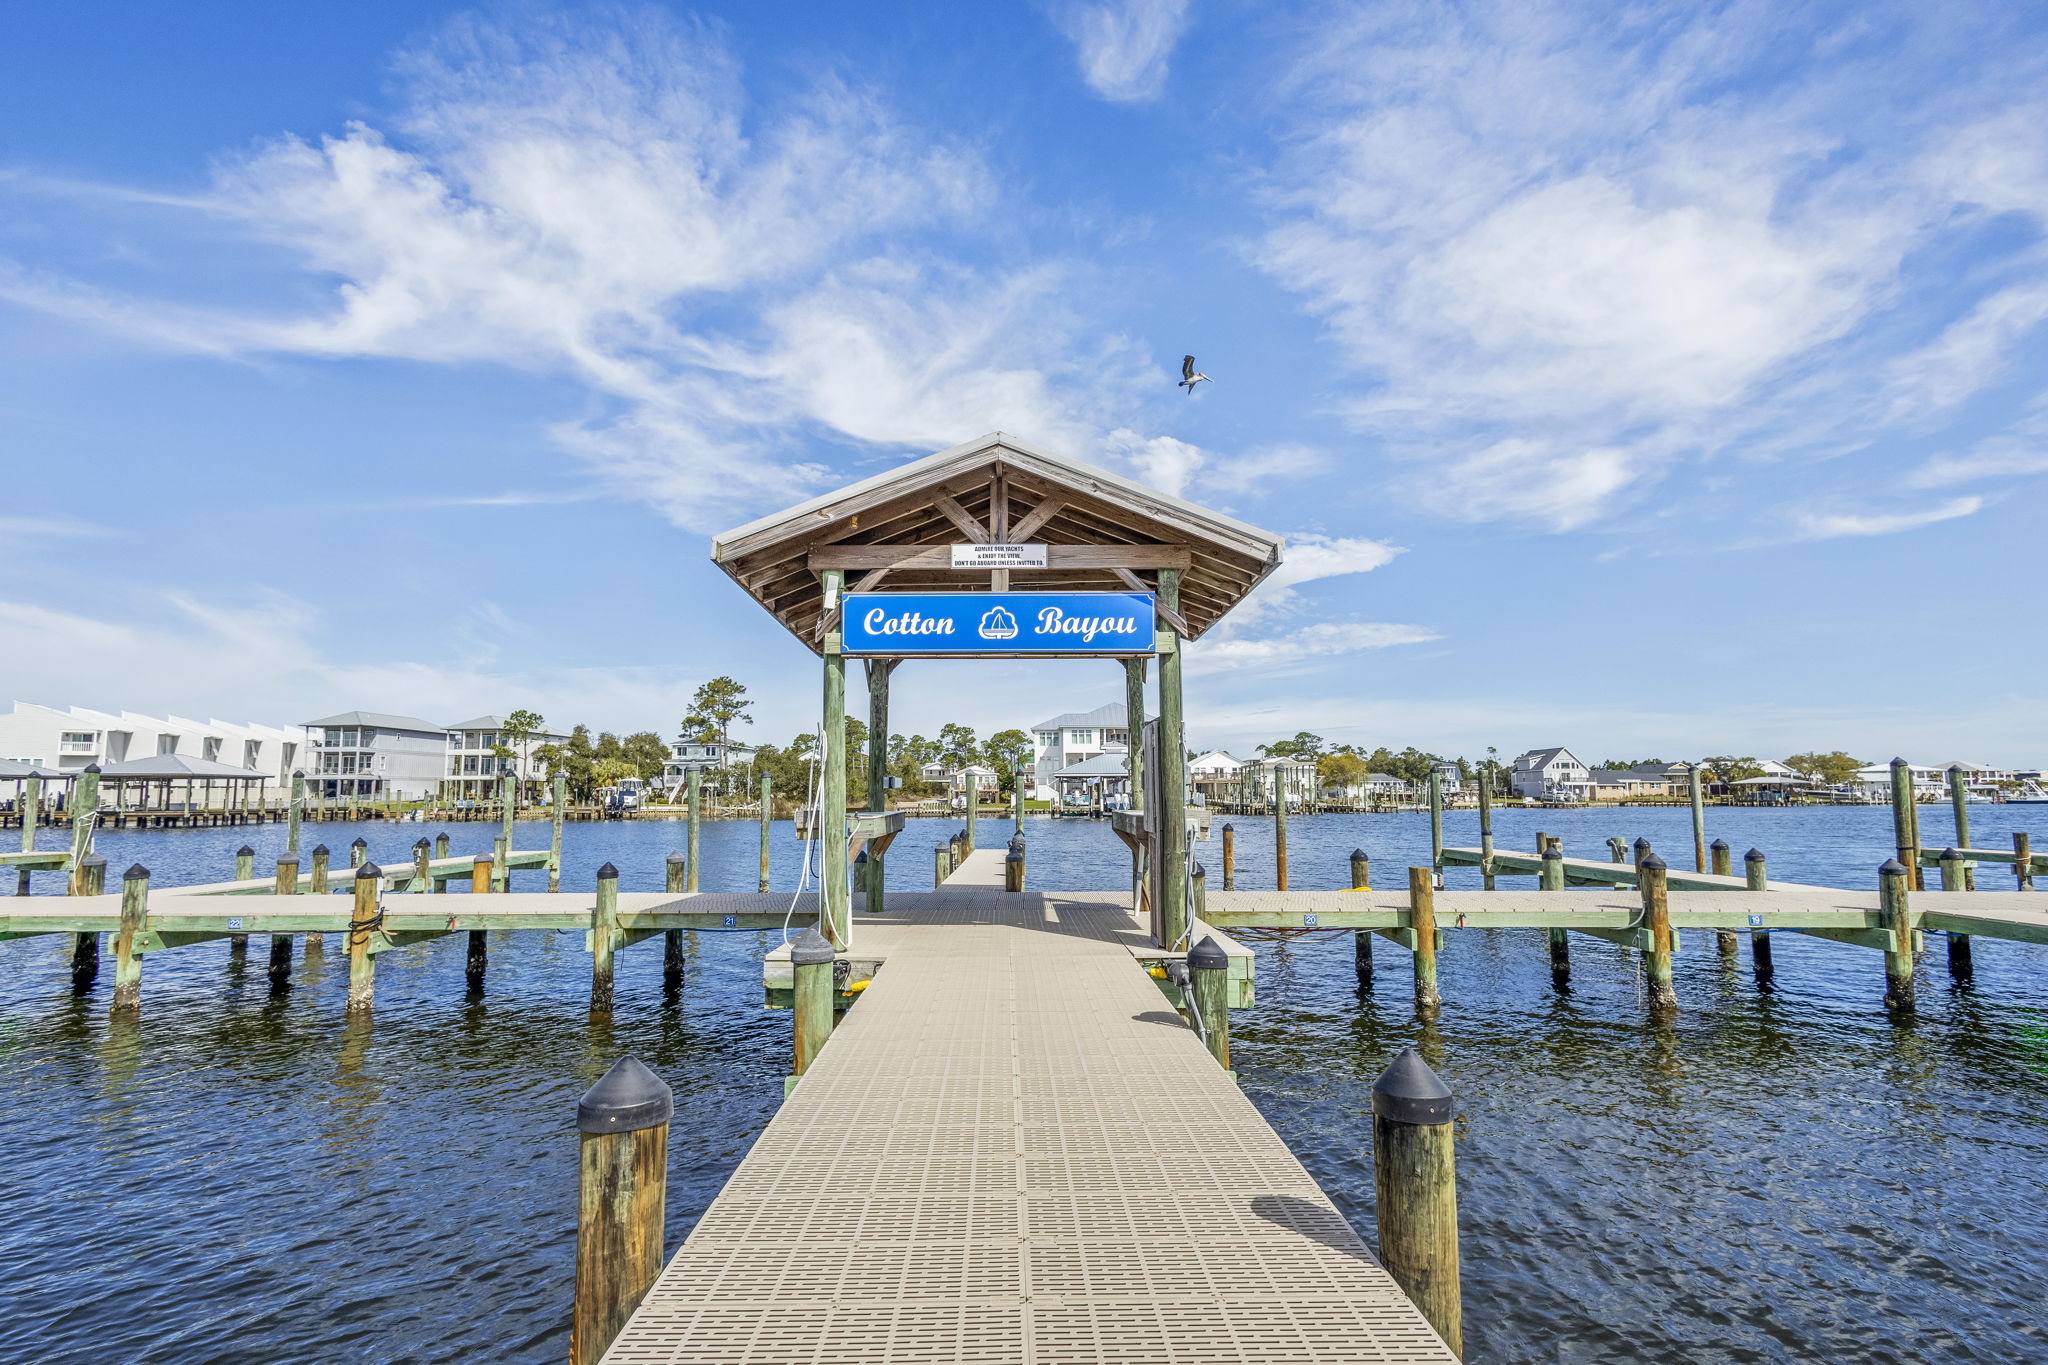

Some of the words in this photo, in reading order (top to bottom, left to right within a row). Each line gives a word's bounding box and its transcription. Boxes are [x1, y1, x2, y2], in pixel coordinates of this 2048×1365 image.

[863, 607, 956, 635] Cotton
[1034, 606, 1137, 643] Bayou
[230, 919, 240, 928] 22
[725, 917, 734, 925] 21
[1306, 916, 1316, 924] 20
[1751, 916, 1760, 924] 19
